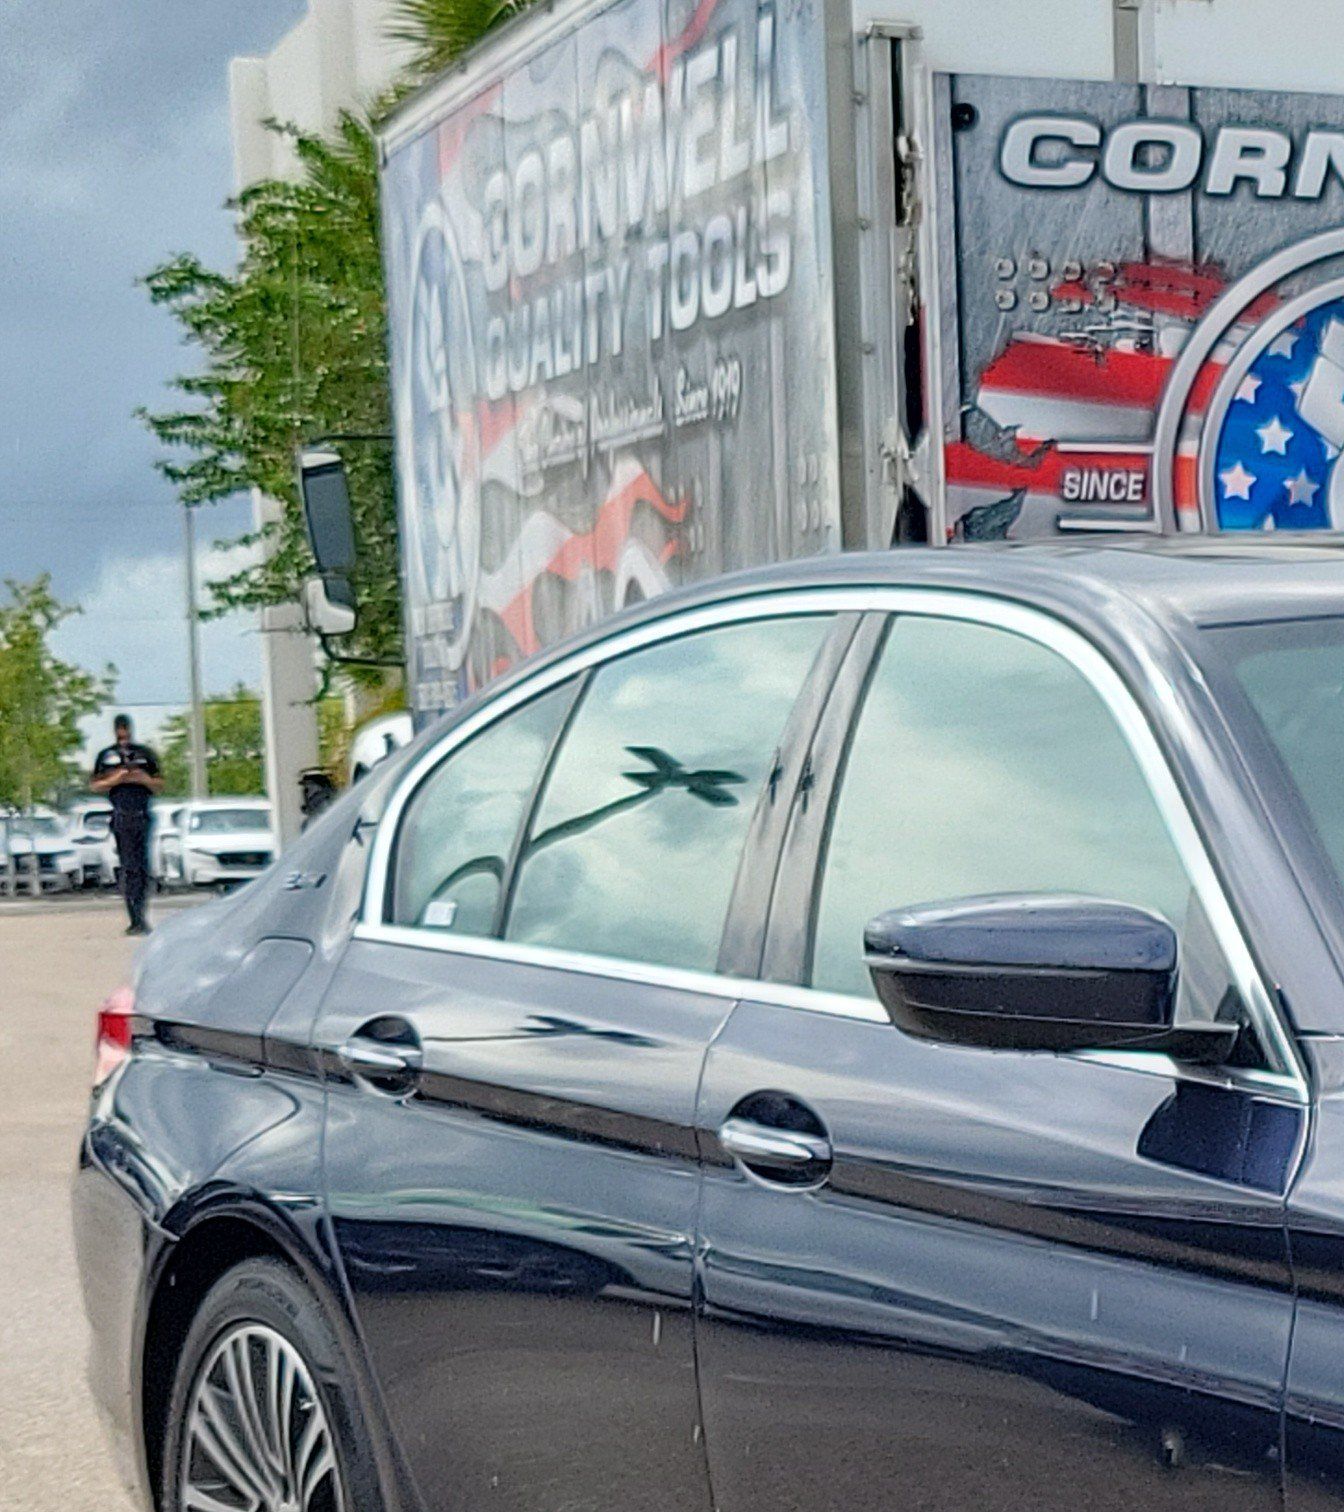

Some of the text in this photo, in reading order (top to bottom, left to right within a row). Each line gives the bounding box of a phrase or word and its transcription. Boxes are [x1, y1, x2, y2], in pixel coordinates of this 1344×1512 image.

[482, 14, 789, 291] CORNWELL
[486, 257, 630, 399] QUALITY
[647, 188, 791, 340] TOOLS
[1063, 468, 1145, 501] SINCE
